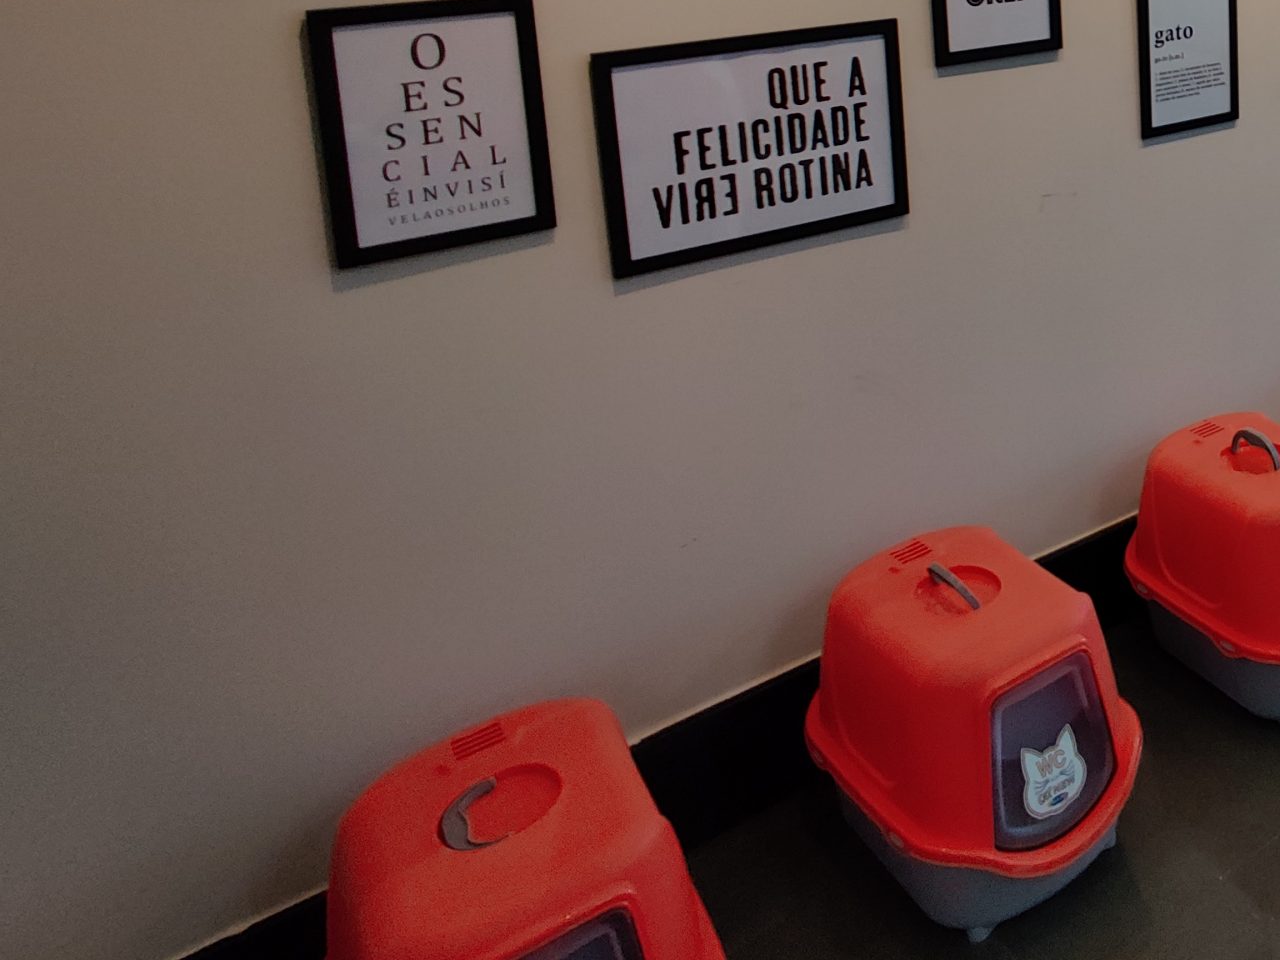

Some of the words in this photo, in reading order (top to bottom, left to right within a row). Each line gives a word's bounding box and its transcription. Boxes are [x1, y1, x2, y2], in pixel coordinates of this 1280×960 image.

[410, 33, 446, 70] O
[1154, 24, 1194, 49] gato
[400, 76, 465, 113] ES
[768, 61, 831, 110] QUE
[849, 56, 867, 98] A
[385, 112, 483, 150] SEN
[673, 102, 870, 175] FELICIDADE
[382, 144, 507, 183] CIAL
[754, 148, 873, 209] ROTINA
[1035, 748, 1067, 778] WC
